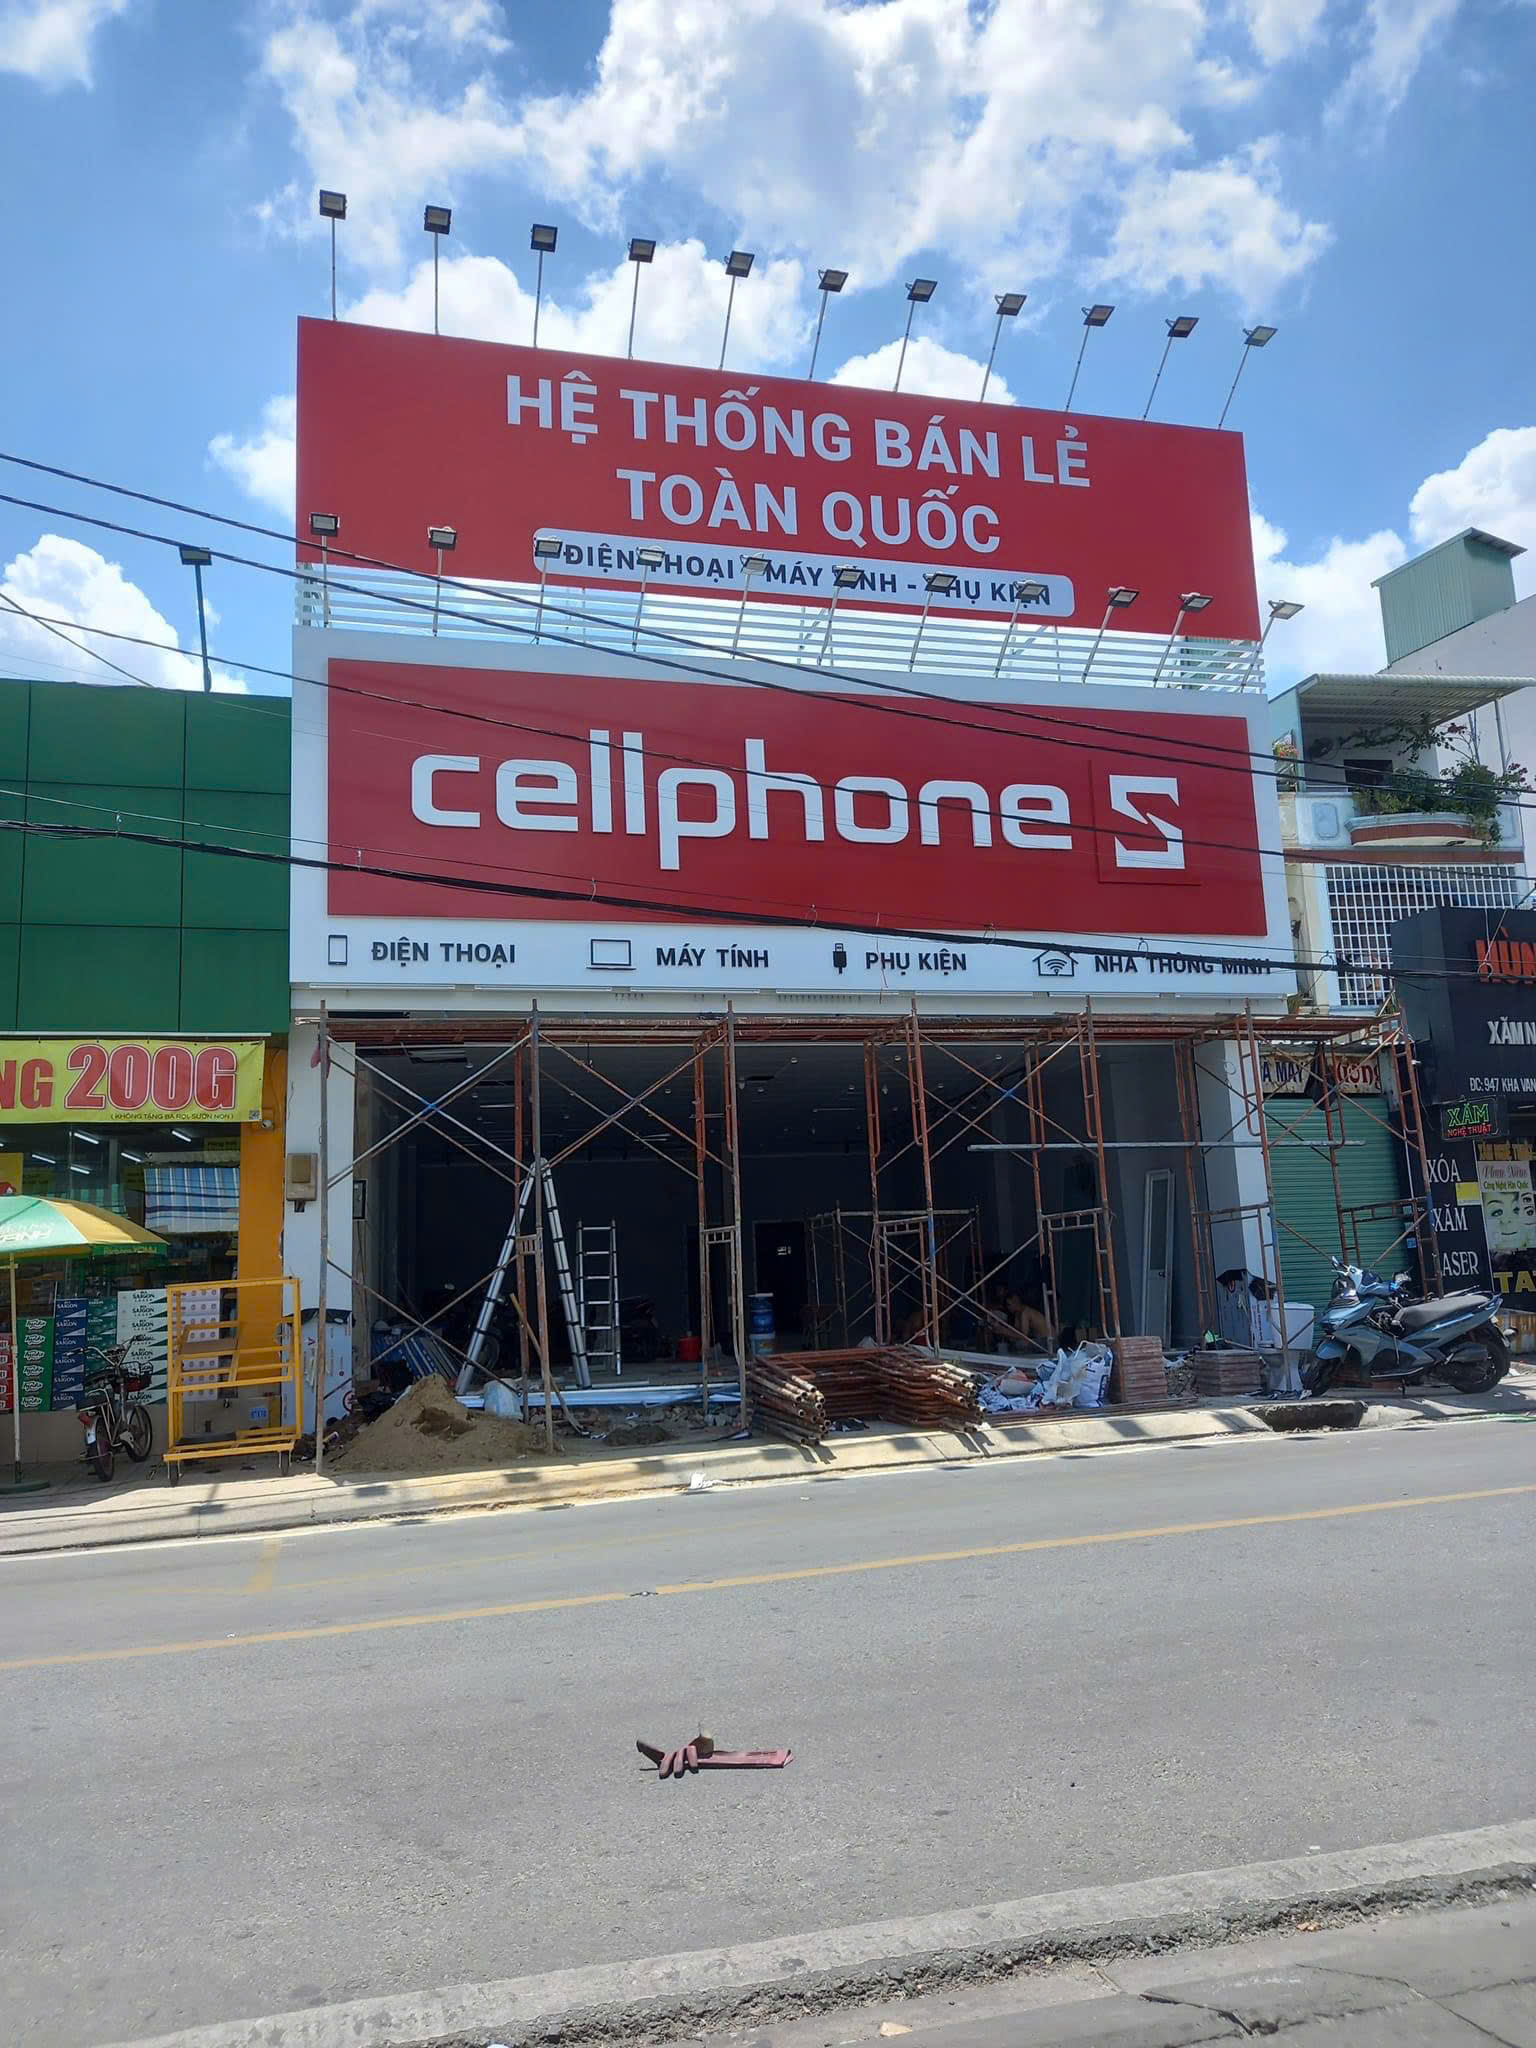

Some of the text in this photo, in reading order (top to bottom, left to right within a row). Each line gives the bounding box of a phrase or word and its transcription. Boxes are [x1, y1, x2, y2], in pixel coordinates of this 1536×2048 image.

[506, 369, 1091, 488] HỆ THỐNG BÁN LẺ
[616, 466, 1001, 554] TOÀN QUỐC
[564, 542, 635, 573] ĐIỆN
[640, 552, 734, 584] HOẠI
[766, 560, 823, 587] MÁY
[371, 936, 516, 969] ĐIỆN THOẠI
[656, 942, 769, 969] MÁY TÍNH
[865, 948, 967, 977] PHỤ KIỆN
[64, 1043, 237, 1112] 200G
[1447, 1104, 1489, 1127] XĂM
[1426, 1153, 1461, 1184] XÓA
[1432, 1203, 1468, 1233] XĂM
[1441, 1251, 1480, 1278] ASER
